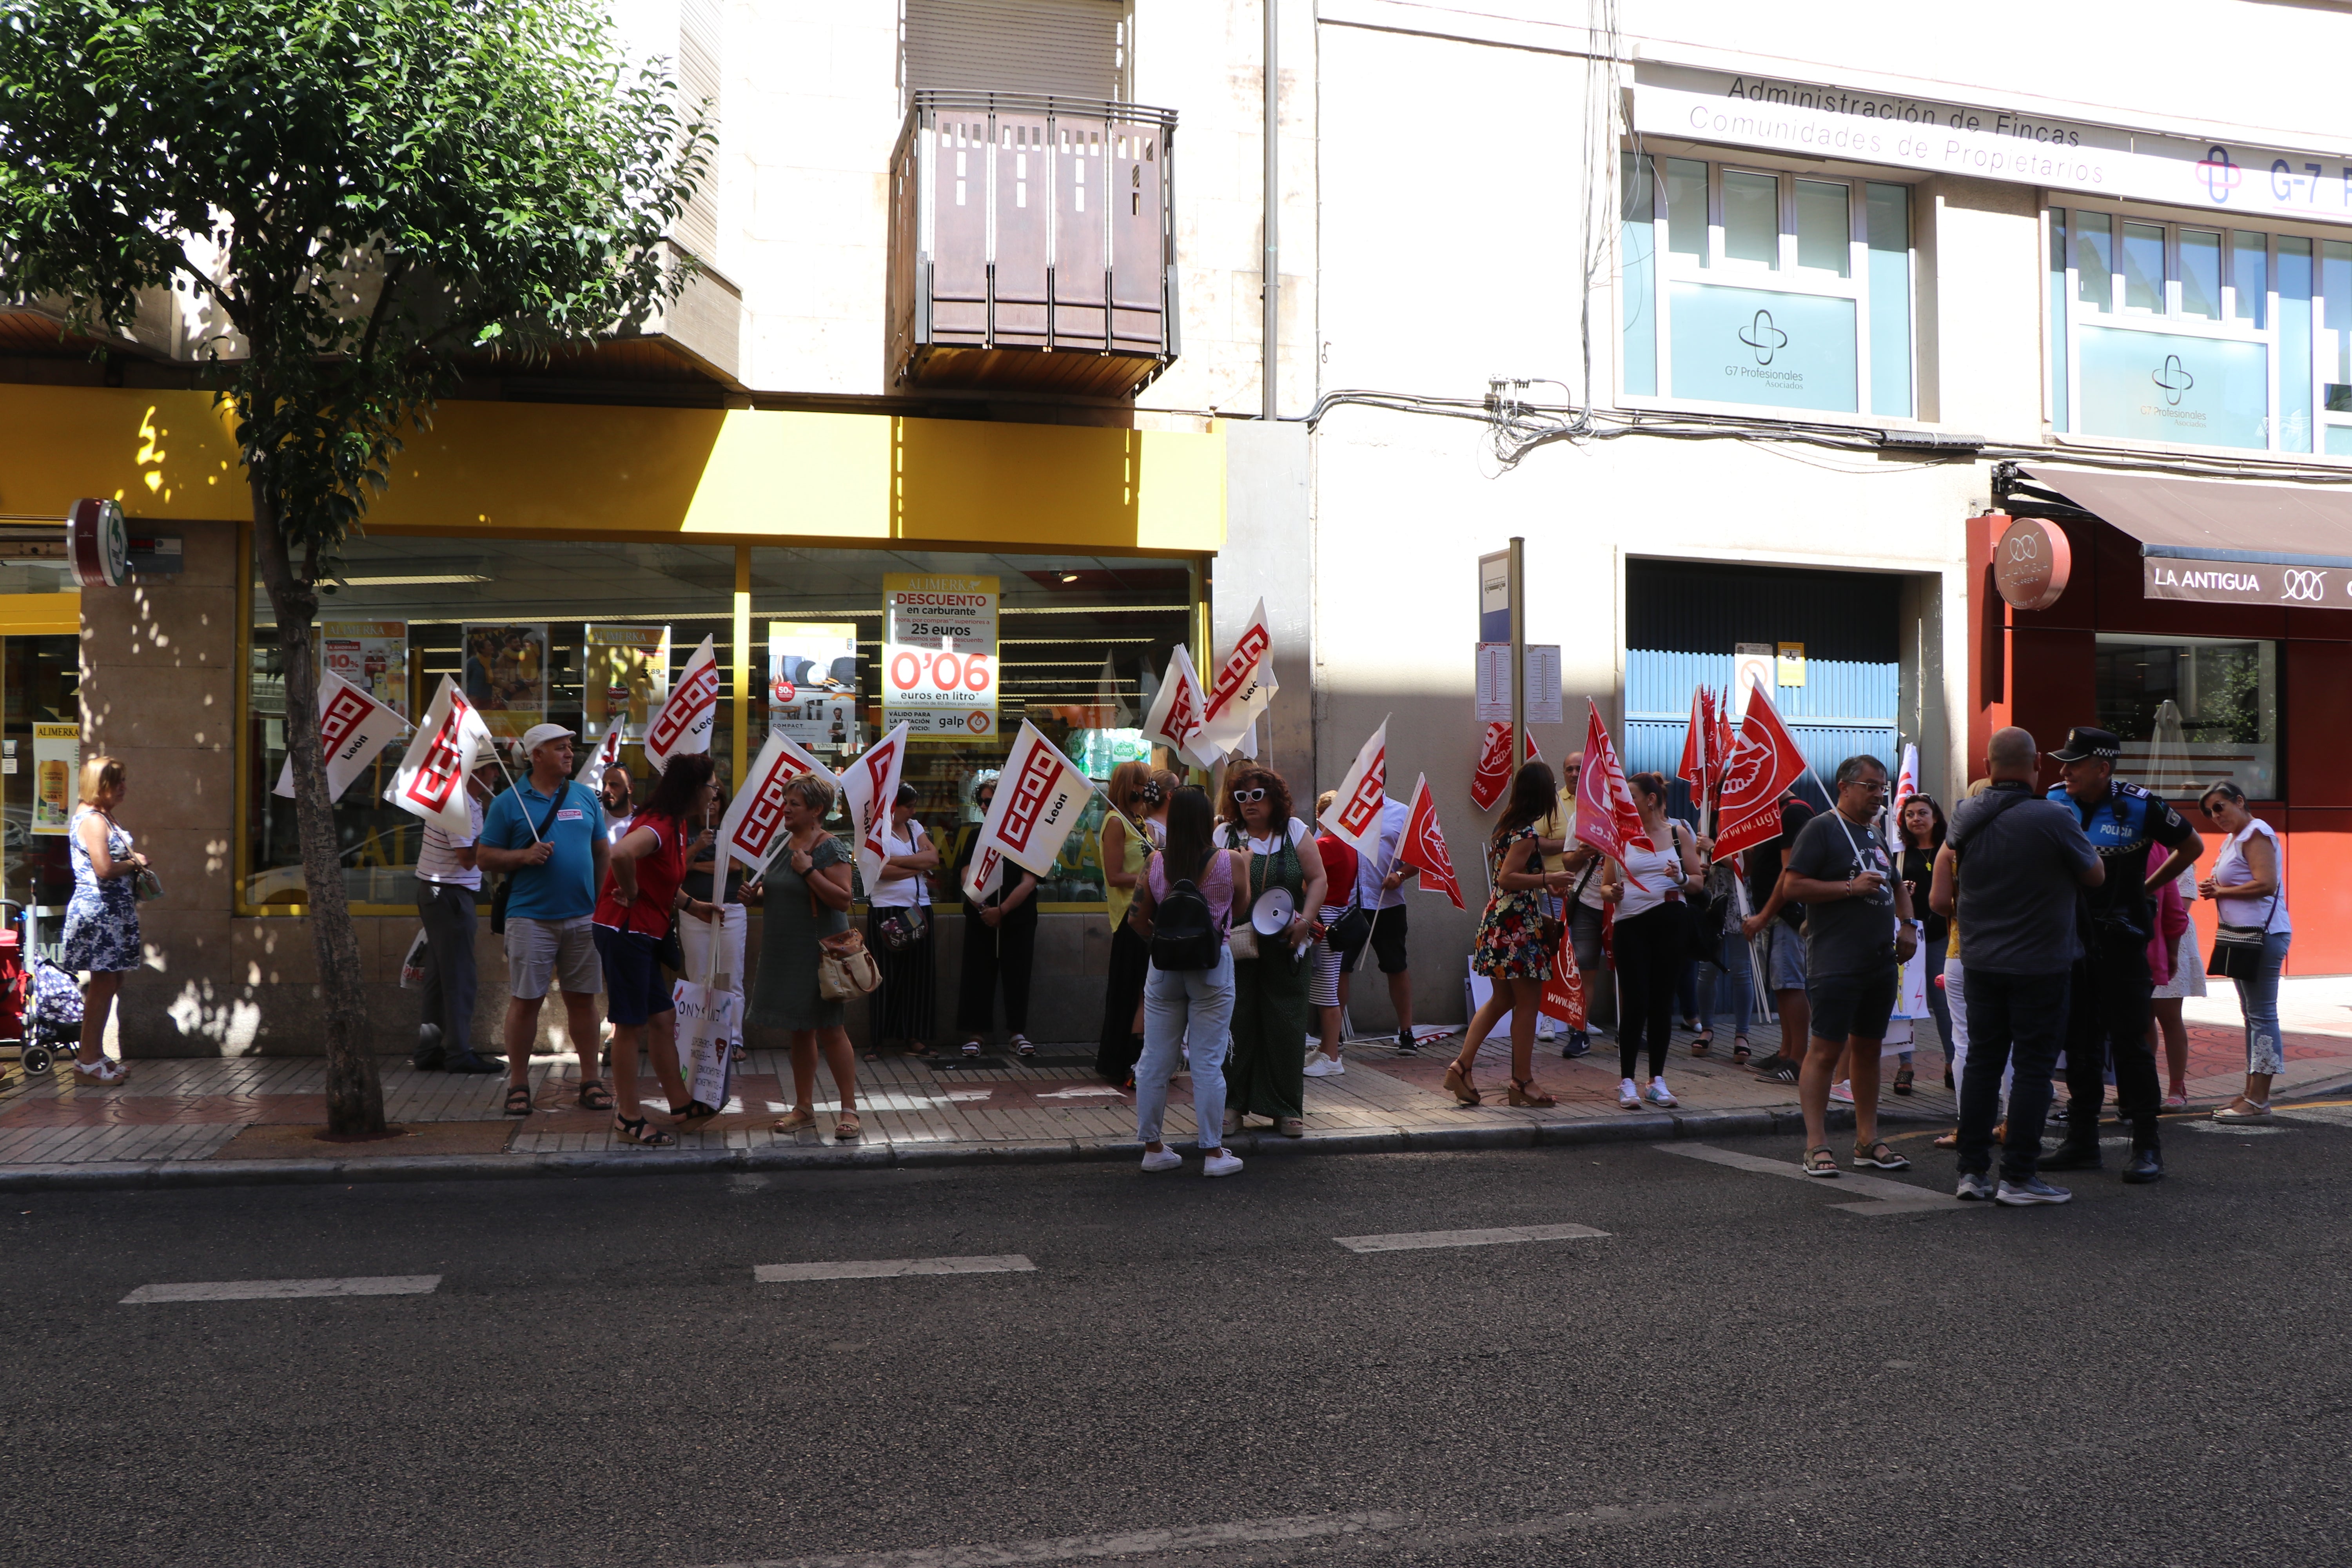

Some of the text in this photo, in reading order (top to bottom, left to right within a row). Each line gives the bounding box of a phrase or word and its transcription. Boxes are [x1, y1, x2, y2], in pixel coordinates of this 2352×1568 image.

[1728, 77, 2079, 147] Administración de Fincas
[1690, 105, 2103, 183] Comunidades de Propietarios
[2271, 159, 2321, 203] G-7
[1725, 365, 1803, 381] G7 Profesionales
[1765, 379, 1803, 390] Asociados
[2154, 407, 2207, 420] Profesionales
[2174, 419, 2207, 428] Asociados
[908, 577, 977, 591] ALIMERKA
[2155, 568, 2260, 591] LA ANTIGUA
[897, 592, 987, 606] DESCUENTO
[922, 606, 976, 616] carburante
[329, 625, 385, 635] ALIMERKA
[593, 631, 646, 642] ALIMERKA
[911, 623, 971, 636] 25 euros
[328, 654, 359, 668] 10%
[653, 667, 719, 746] CCOO
[939, 715, 964, 728] galp
[38, 727, 79, 736] ALIMERKA
[341, 734, 368, 760] León
[1004, 748, 1059, 842] CCOO
[740, 760, 802, 848] CCOO
[1044, 793, 1068, 825] León
[2100, 824, 2132, 837] POLICÍA
[1547, 992, 1583, 1016] www.ugt.es
